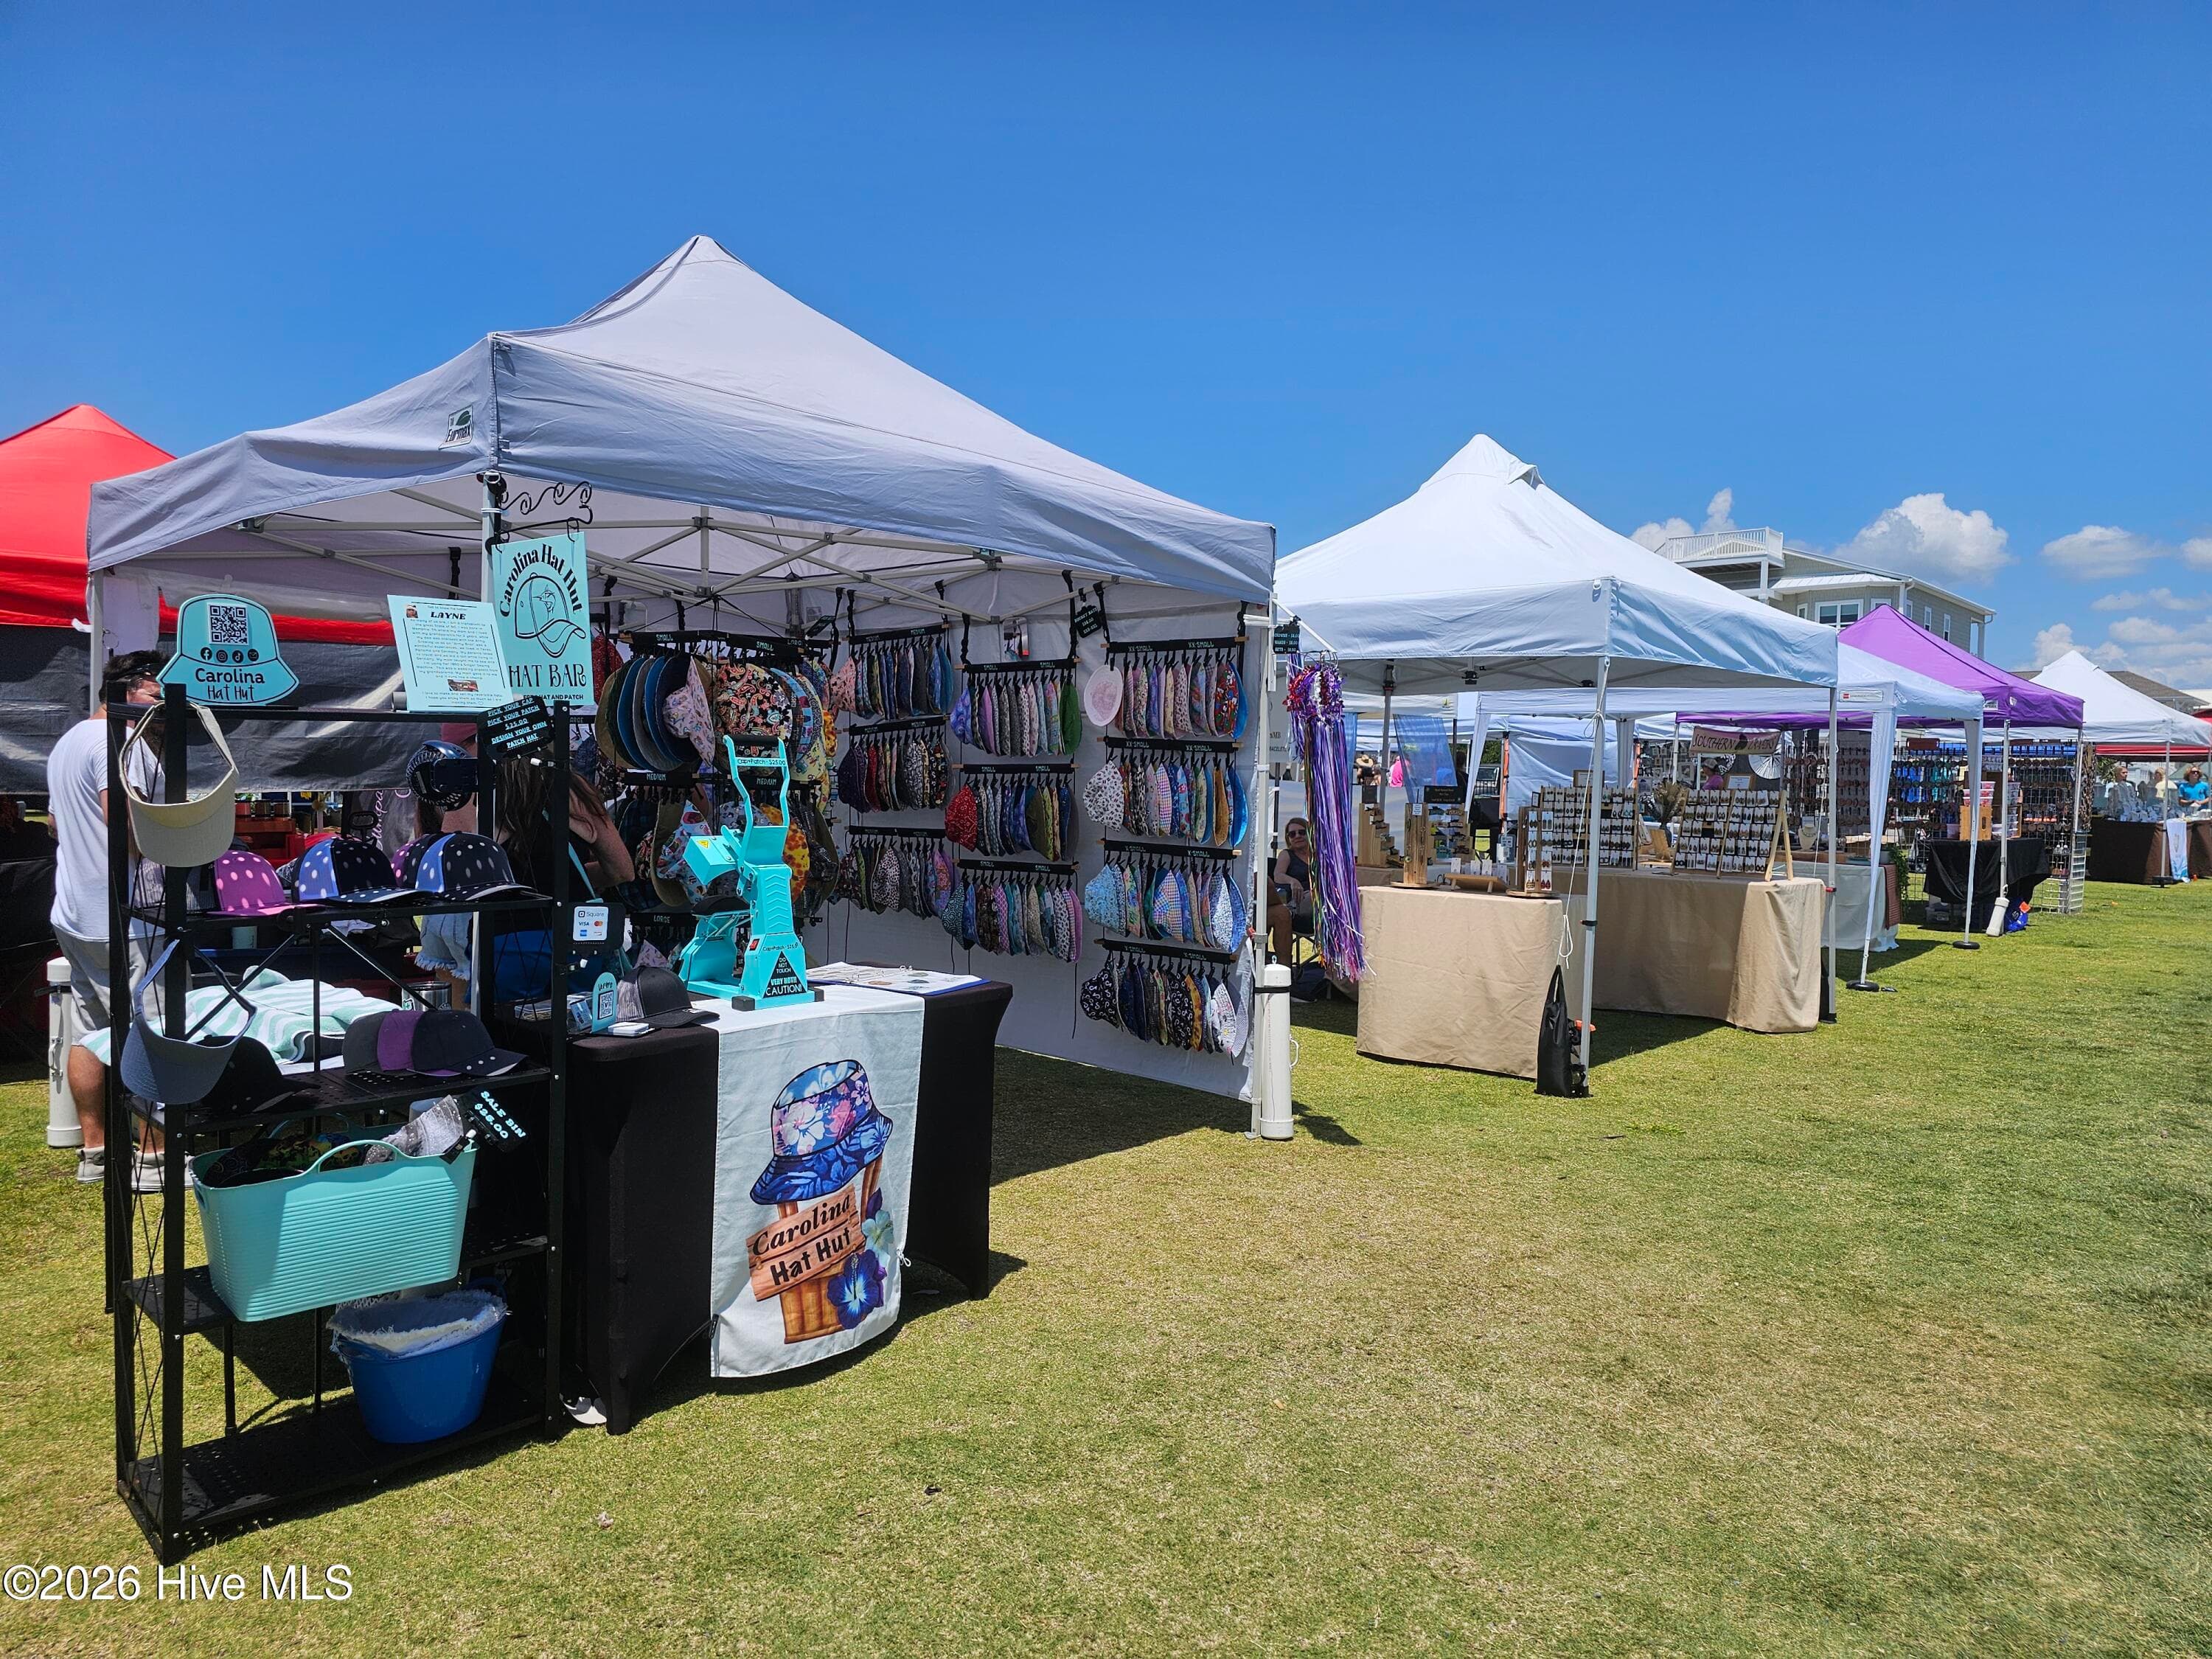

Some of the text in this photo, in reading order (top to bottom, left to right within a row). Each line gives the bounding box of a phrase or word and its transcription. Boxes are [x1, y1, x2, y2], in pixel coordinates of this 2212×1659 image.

[500, 543, 582, 616] Carolina Hat Hut
[431, 611, 466, 619] LAYNE
[756, 641, 774, 650] SMALL
[195, 668, 265, 684] Carolina
[509, 664, 587, 687] HAT BAR
[207, 684, 254, 700] Hat Hut
[487, 709, 503, 717] PICK
[504, 703, 521, 712] YOUR
[487, 705, 540, 727] PICK YOUR PATCH
[491, 721, 547, 745] DESIGN YOUR OWN
[507, 733, 538, 748] PATCH HAT
[1693, 734, 1735, 750] SOUTHERN
[757, 777, 776, 785] MEDIUM
[653, 915, 670, 923] LARGE
[766, 984, 802, 996] CAUTION!
[481, 1091, 526, 1138] SALE BIN
[752, 1194, 850, 1256] Carolina
[770, 1227, 850, 1286] Hat Hut
